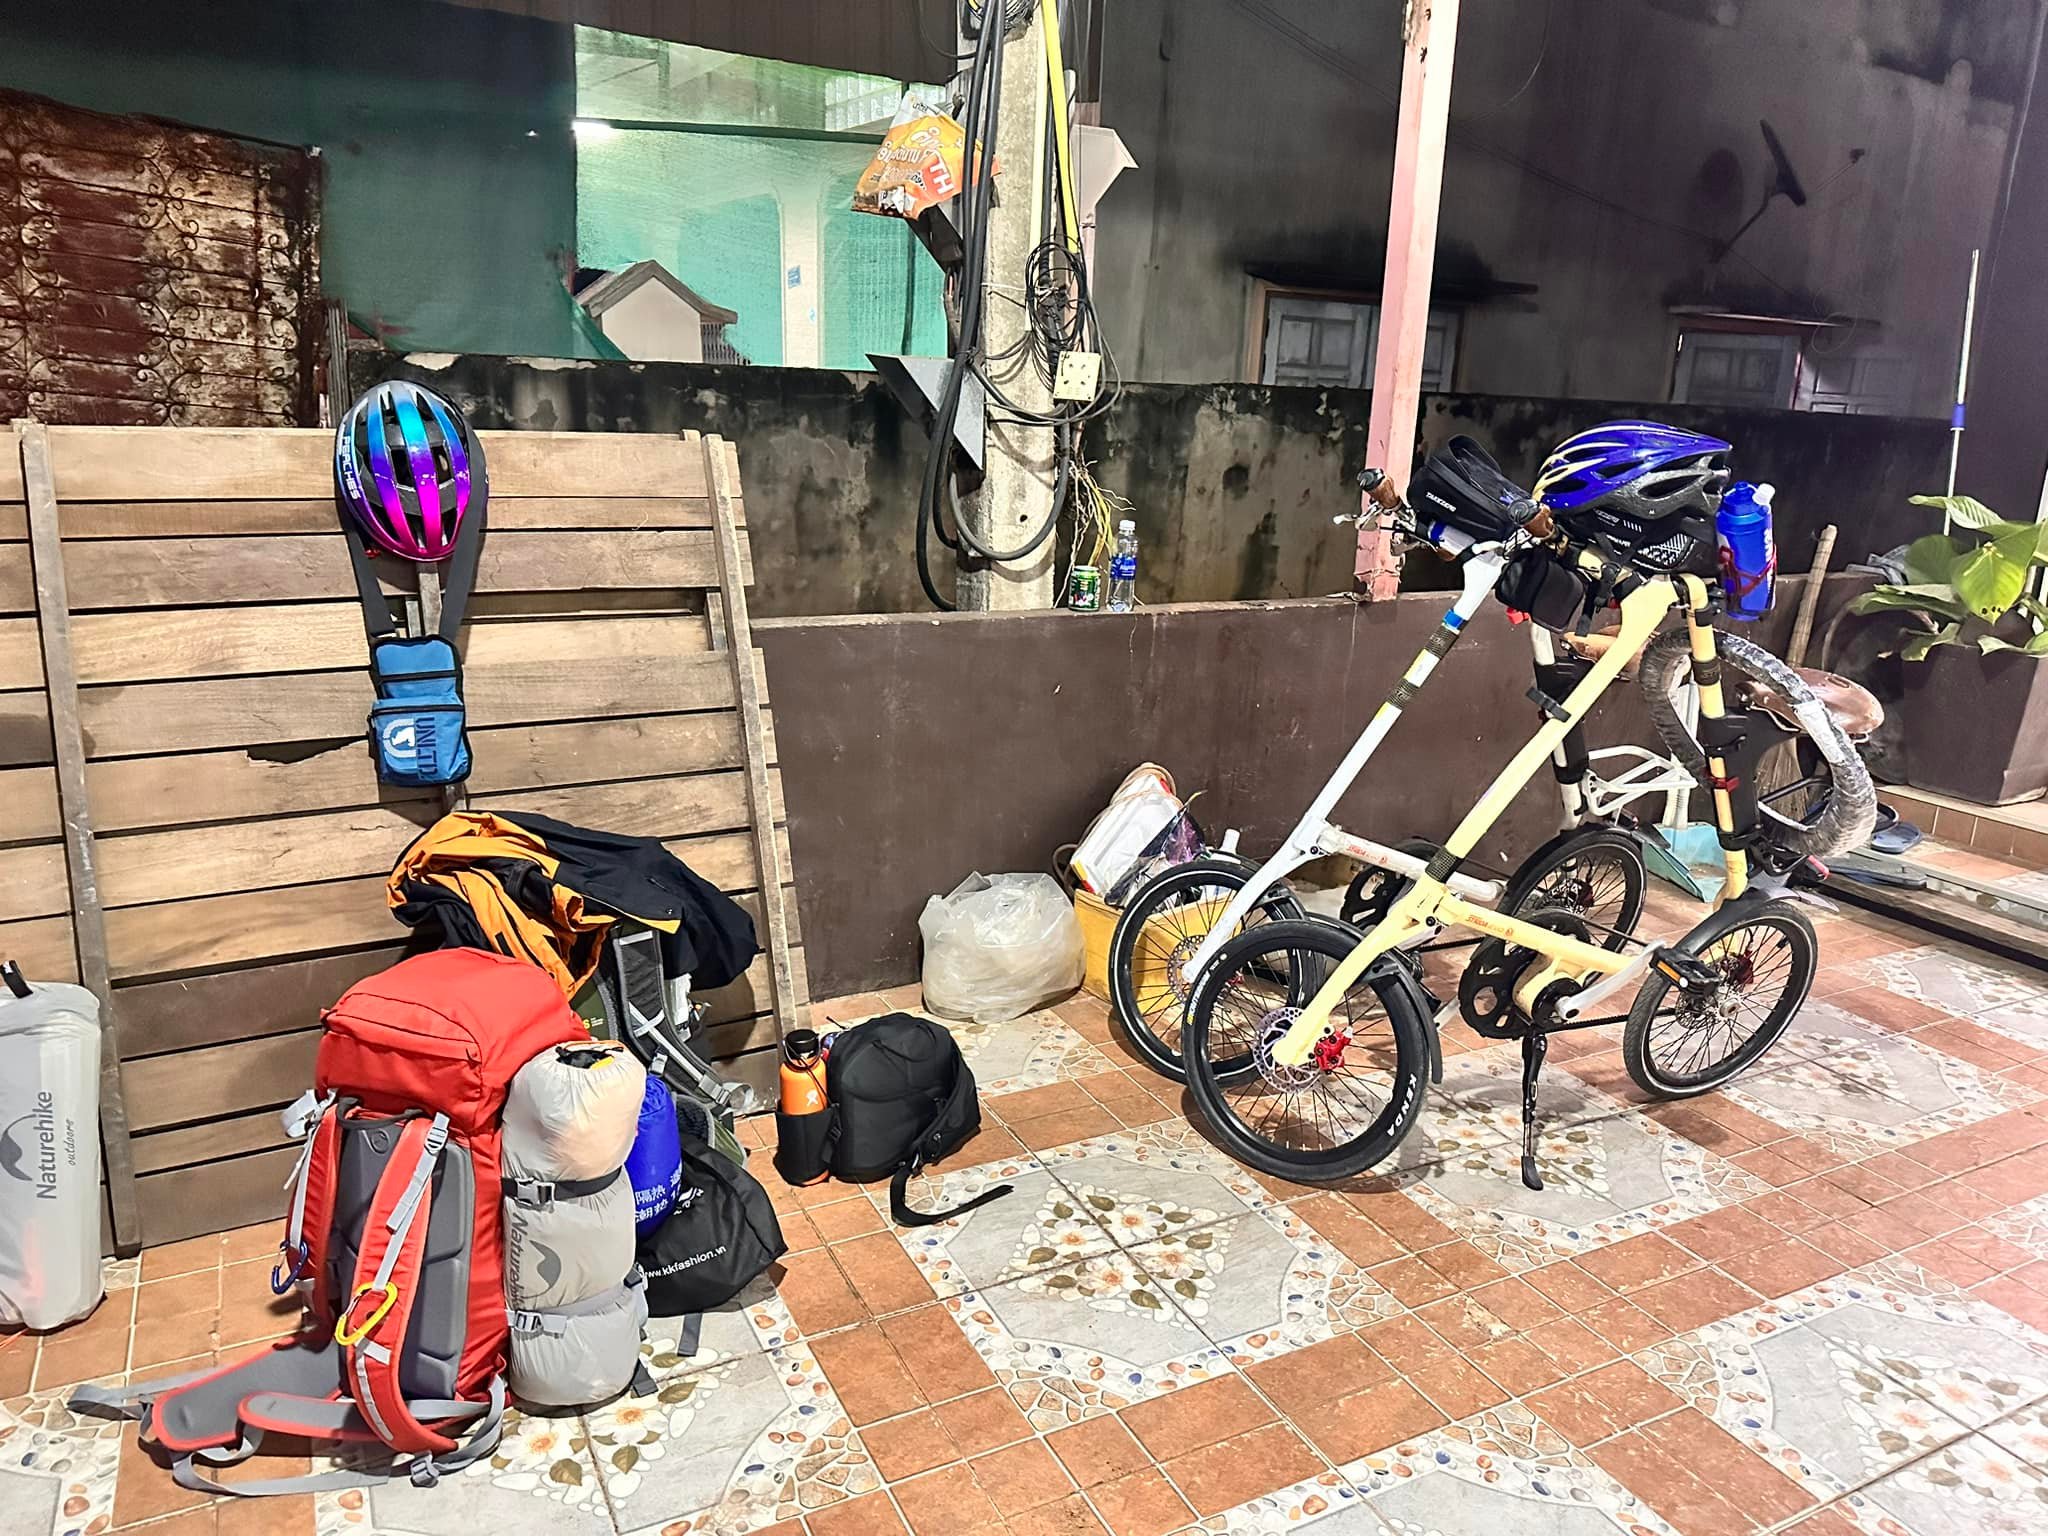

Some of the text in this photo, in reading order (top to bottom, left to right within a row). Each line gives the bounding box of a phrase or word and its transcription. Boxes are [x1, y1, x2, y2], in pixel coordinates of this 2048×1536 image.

[342, 436, 361, 499] PEACHES
[416, 717, 437, 774] UNLTD
[1387, 1073, 1417, 1137] KENDA
[36, 1091, 57, 1199] Naturehike
